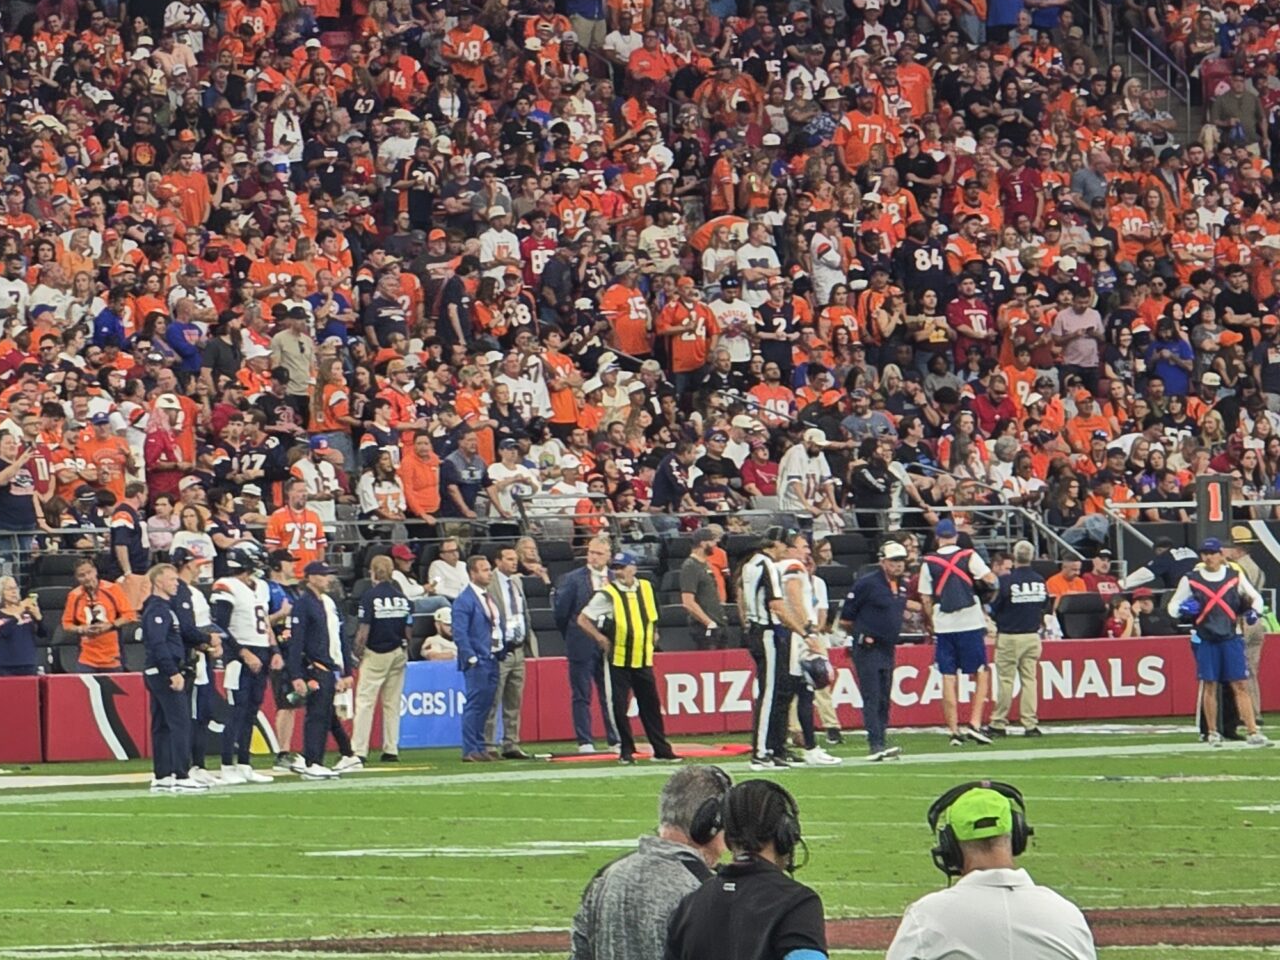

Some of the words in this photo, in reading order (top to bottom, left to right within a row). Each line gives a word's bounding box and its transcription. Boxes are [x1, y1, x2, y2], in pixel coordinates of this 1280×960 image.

[354, 100, 374, 113] 47
[858, 125, 884, 143] 77
[1014, 185, 1023, 201] 1
[563, 209, 585, 229] 92
[656, 239, 679, 258] 85
[915, 250, 943, 270] 84
[990, 272, 1004, 290] 2
[628, 296, 648, 319] 15
[774, 318, 786, 334] 2
[969, 315, 986, 331] 10
[35, 459, 49, 480] 11
[1208, 481, 1222, 521] 1
[286, 524, 318, 550] 72
[256, 605, 266, 633] 8
[408, 691, 447, 715] CBS
